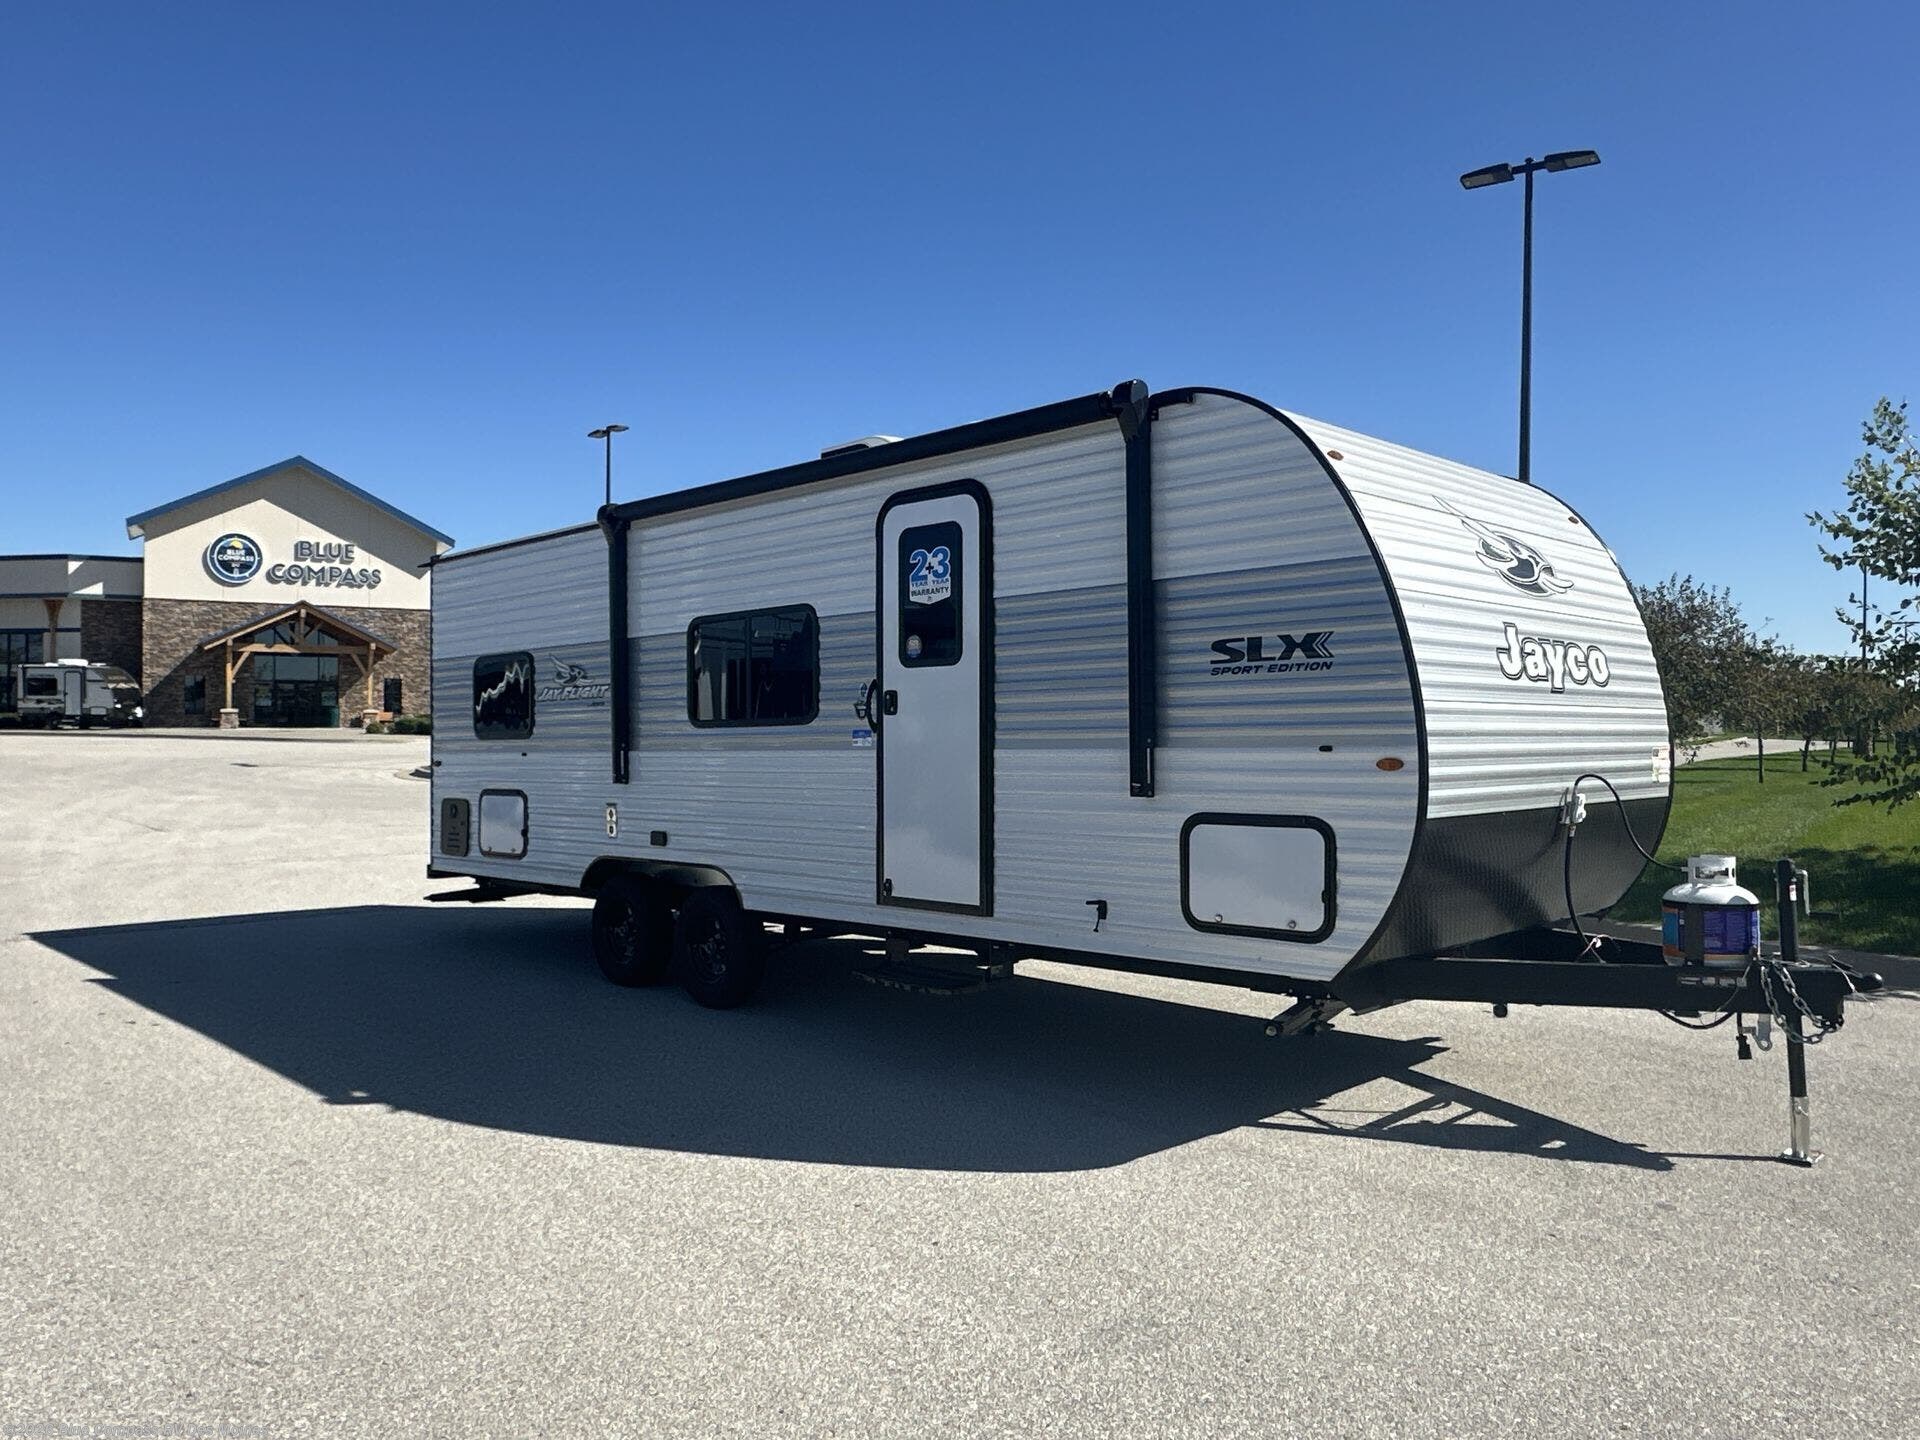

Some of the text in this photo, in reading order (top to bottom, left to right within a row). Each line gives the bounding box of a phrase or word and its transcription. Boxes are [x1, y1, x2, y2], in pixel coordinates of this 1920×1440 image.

[297, 541, 355, 563] BLUE
[268, 563, 382, 588] COMPASS
[910, 586, 950, 597] WARRANTY
[1210, 631, 1335, 664] SLX
[1496, 621, 1610, 693] Jayco
[1210, 661, 1333, 676] SPORT EDITION
[537, 685, 610, 701] JAY FLIGHT
